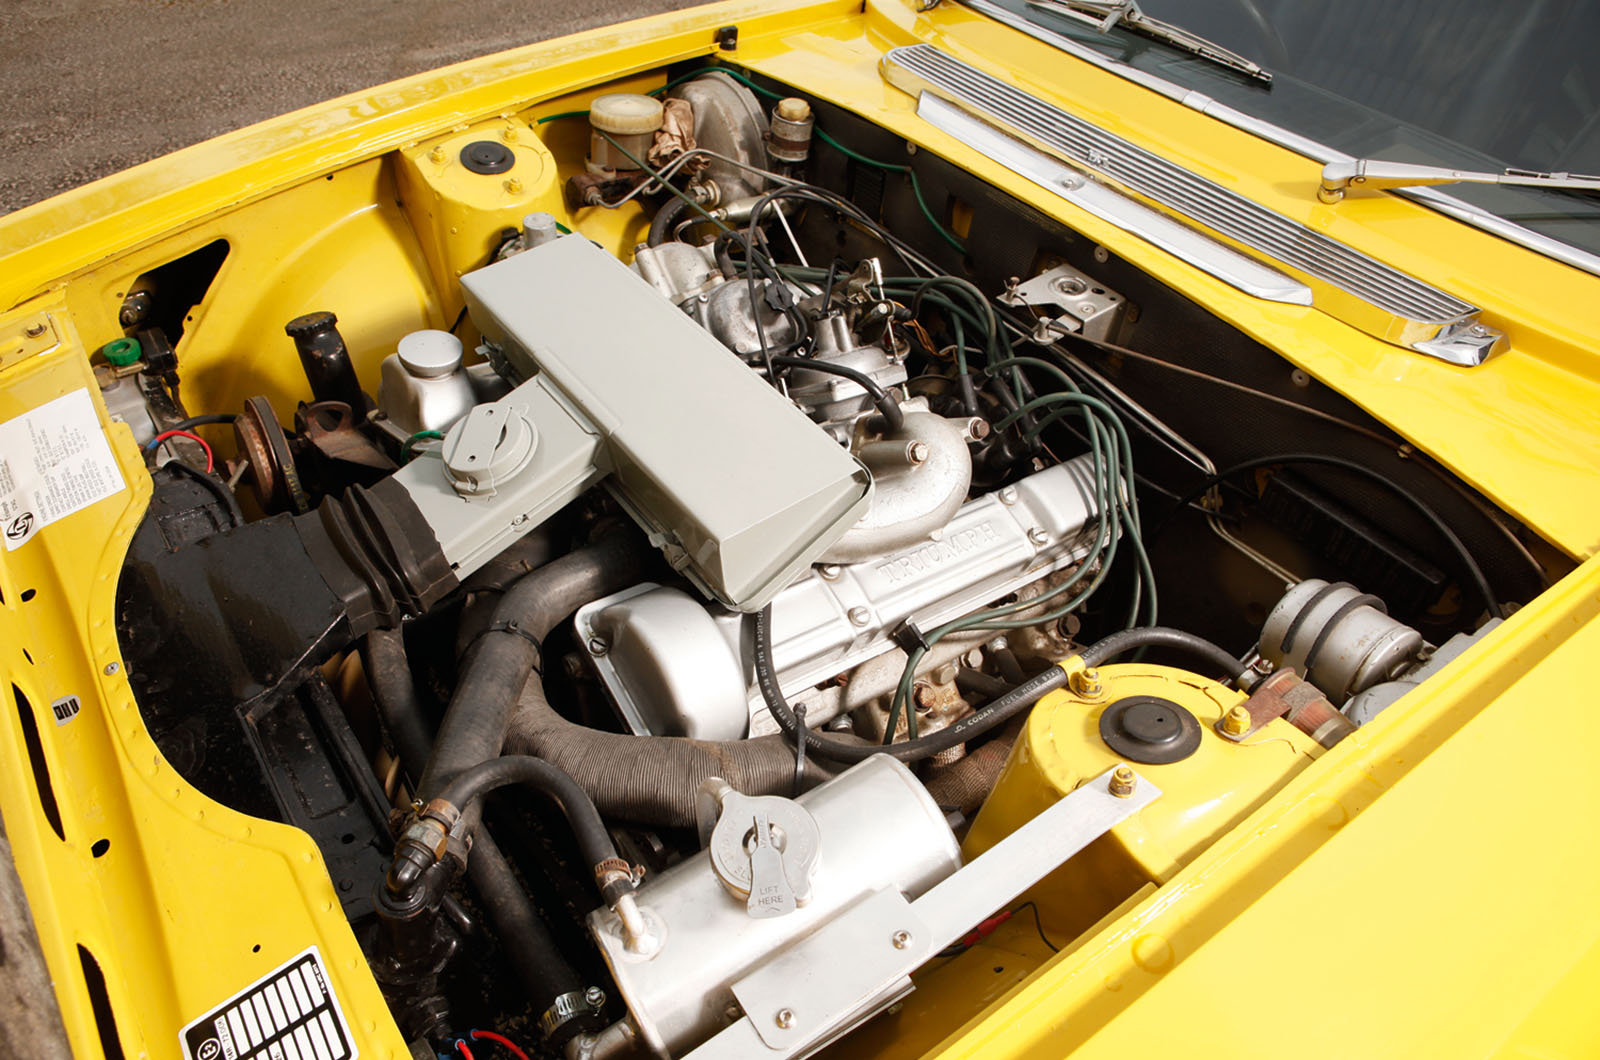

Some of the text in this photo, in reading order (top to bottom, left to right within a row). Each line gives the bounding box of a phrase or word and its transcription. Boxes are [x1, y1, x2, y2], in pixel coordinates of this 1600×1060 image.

[876, 521, 1000, 583] TRIUMPH
[967, 708, 994, 726] CODAN
[1001, 693, 1019, 706] FUEL
[1021, 681, 1041, 695] HOSE
[758, 895, 784, 906] HERE
[759, 886, 779, 896] LIFT
